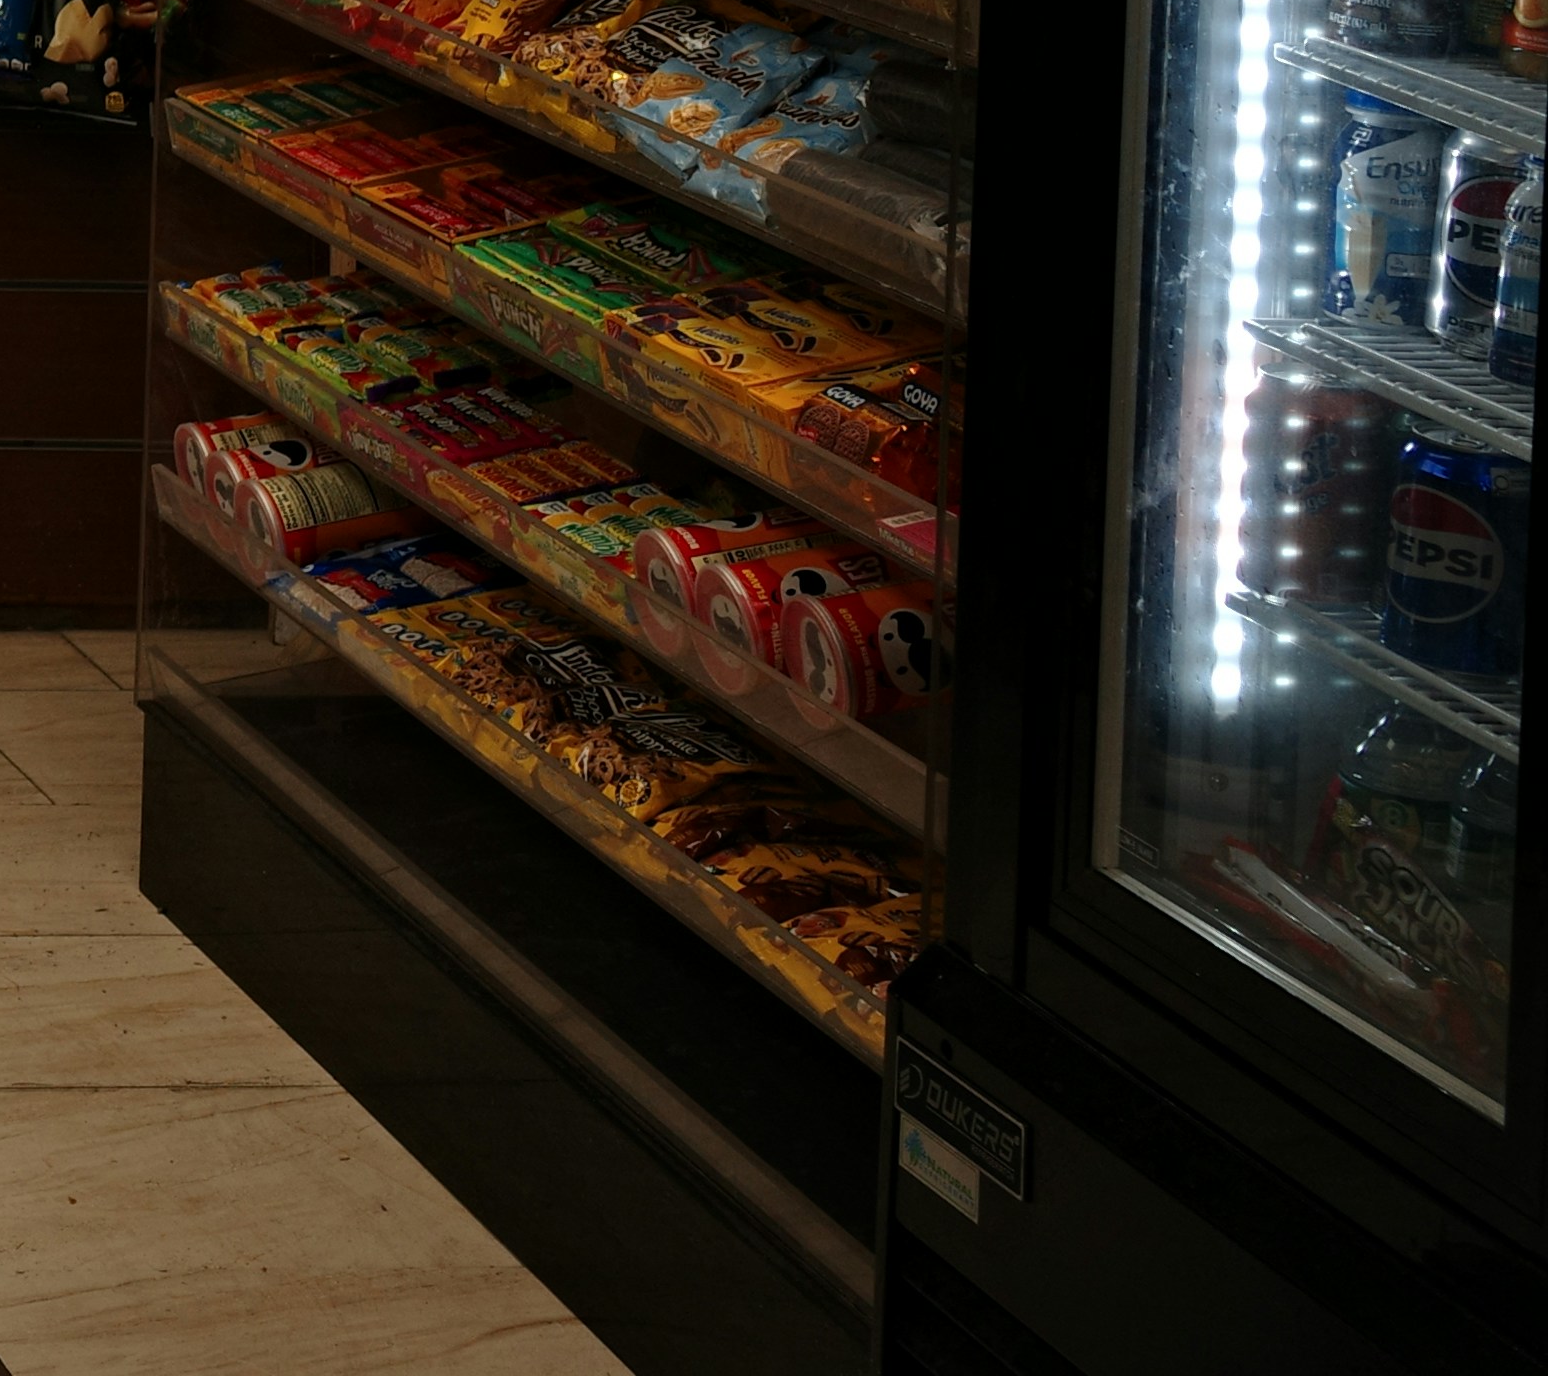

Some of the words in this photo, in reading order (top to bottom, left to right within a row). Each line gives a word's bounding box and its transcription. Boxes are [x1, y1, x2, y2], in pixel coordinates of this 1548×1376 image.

[826, 385, 865, 408] GOYA
[904, 384, 940, 413] GOYA
[926, 1079, 1014, 1163] DUKERS
